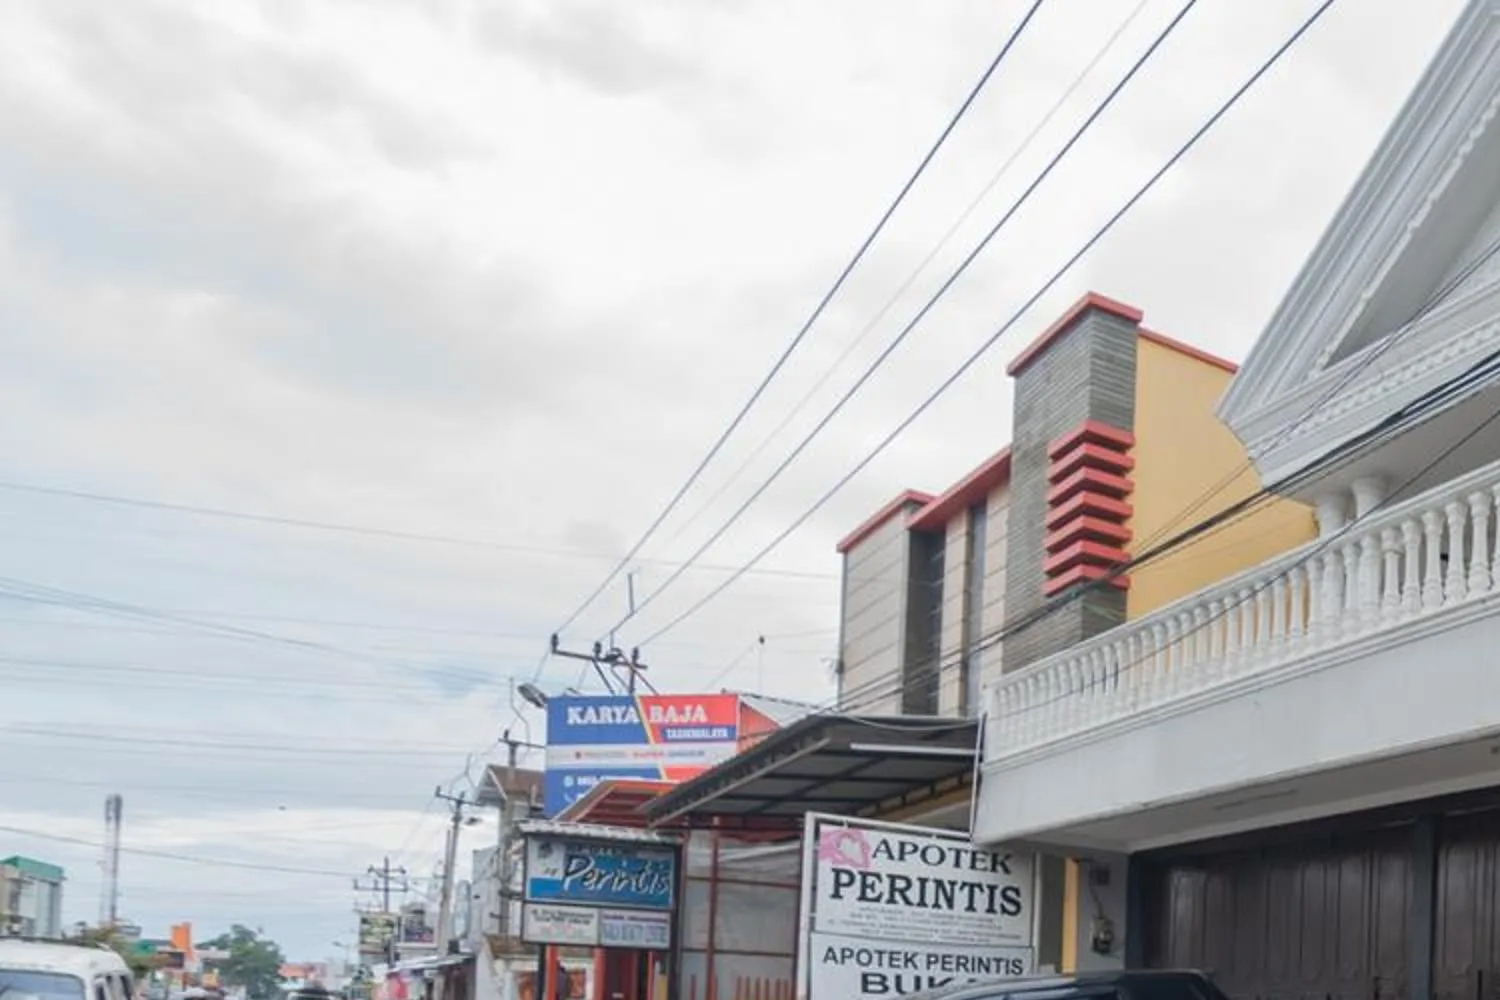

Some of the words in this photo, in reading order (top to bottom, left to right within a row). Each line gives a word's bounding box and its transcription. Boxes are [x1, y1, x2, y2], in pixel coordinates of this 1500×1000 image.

[567, 706, 640, 725] KARYA
[649, 704, 708, 723] BAJA
[872, 838, 1012, 875] APOTEK
[829, 868, 1022, 916] PERINTIS
[823, 946, 918, 970] APOTEK
[926, 953, 1023, 975] PERINTIS
